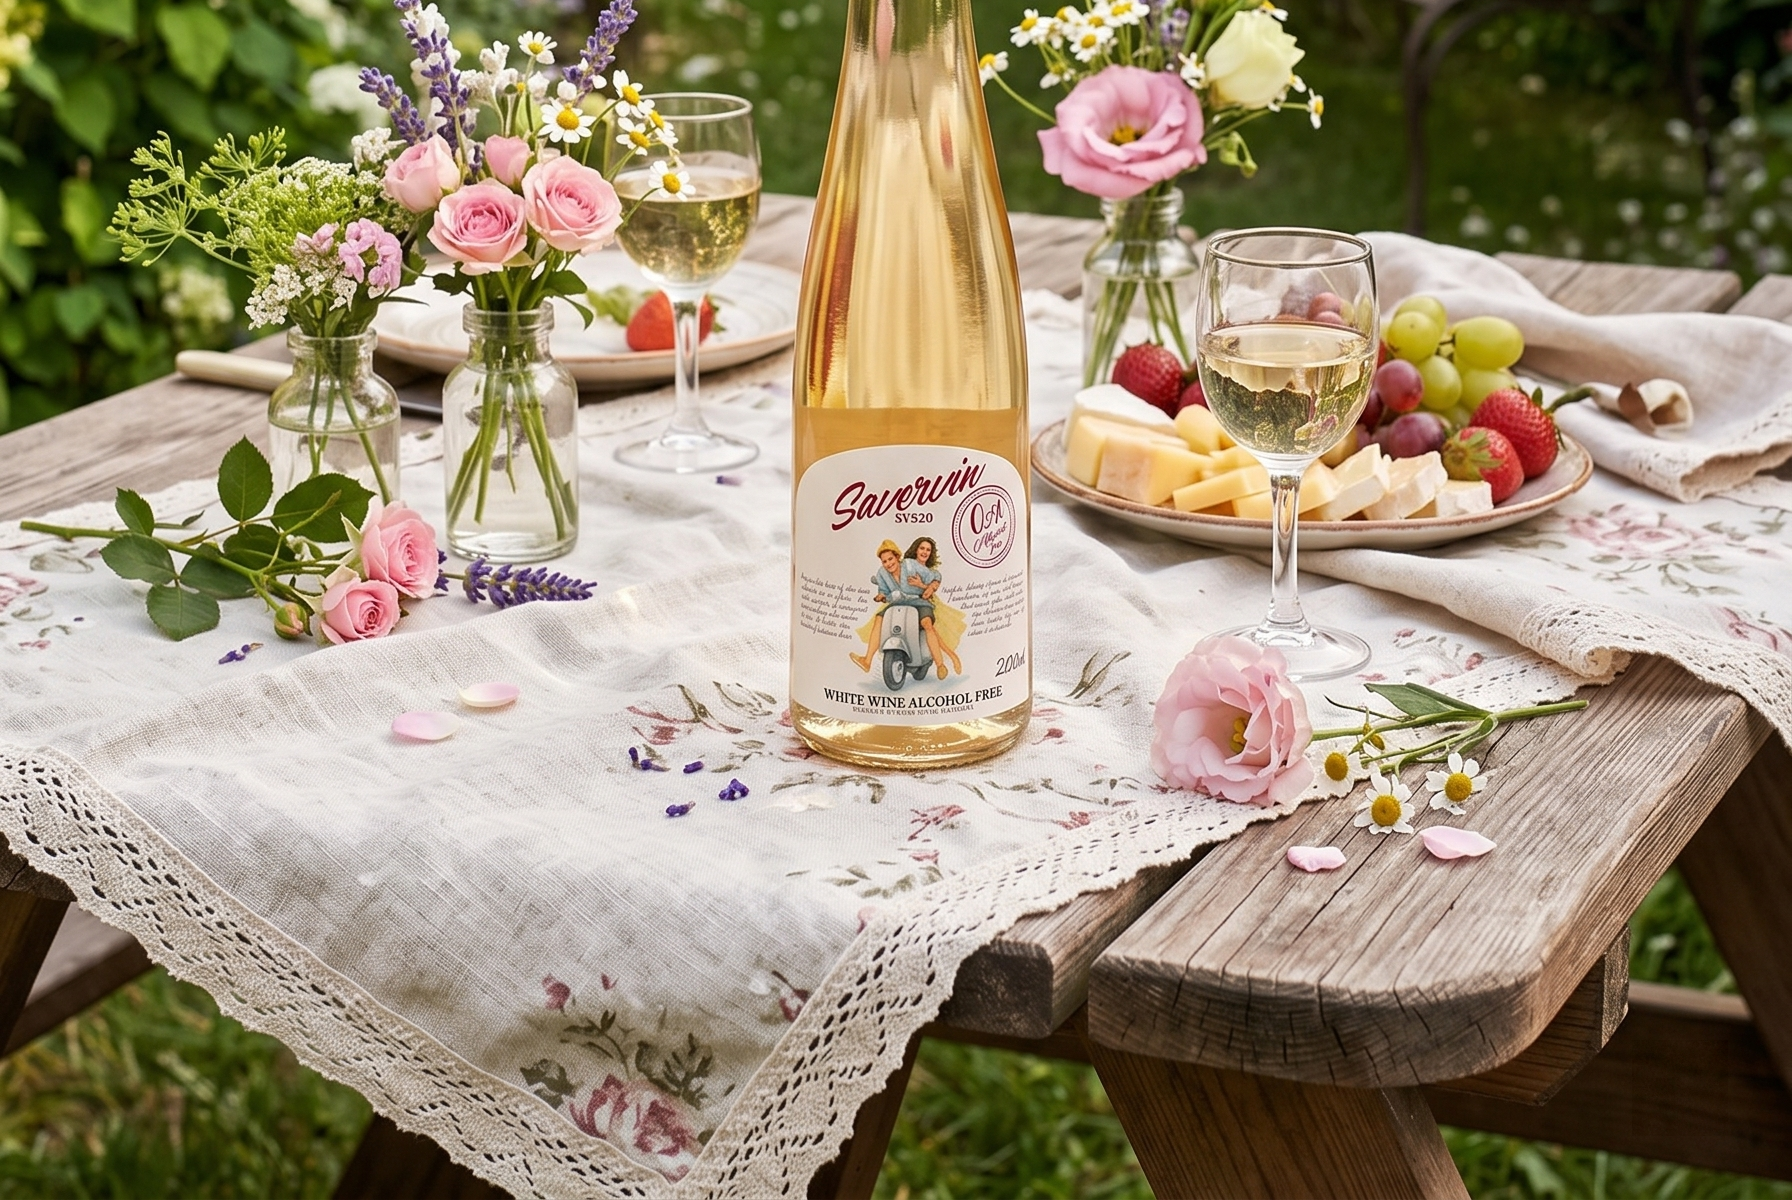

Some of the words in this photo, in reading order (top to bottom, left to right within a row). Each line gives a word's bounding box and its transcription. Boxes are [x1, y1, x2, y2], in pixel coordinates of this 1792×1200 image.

[831, 457, 987, 531] Savervin
[895, 512, 934, 523] SV520
[823, 687, 865, 706] WHITE
[868, 695, 906, 709] WINE
[908, 692, 973, 709] ALCOHOL
[975, 685, 1003, 702] FREE
